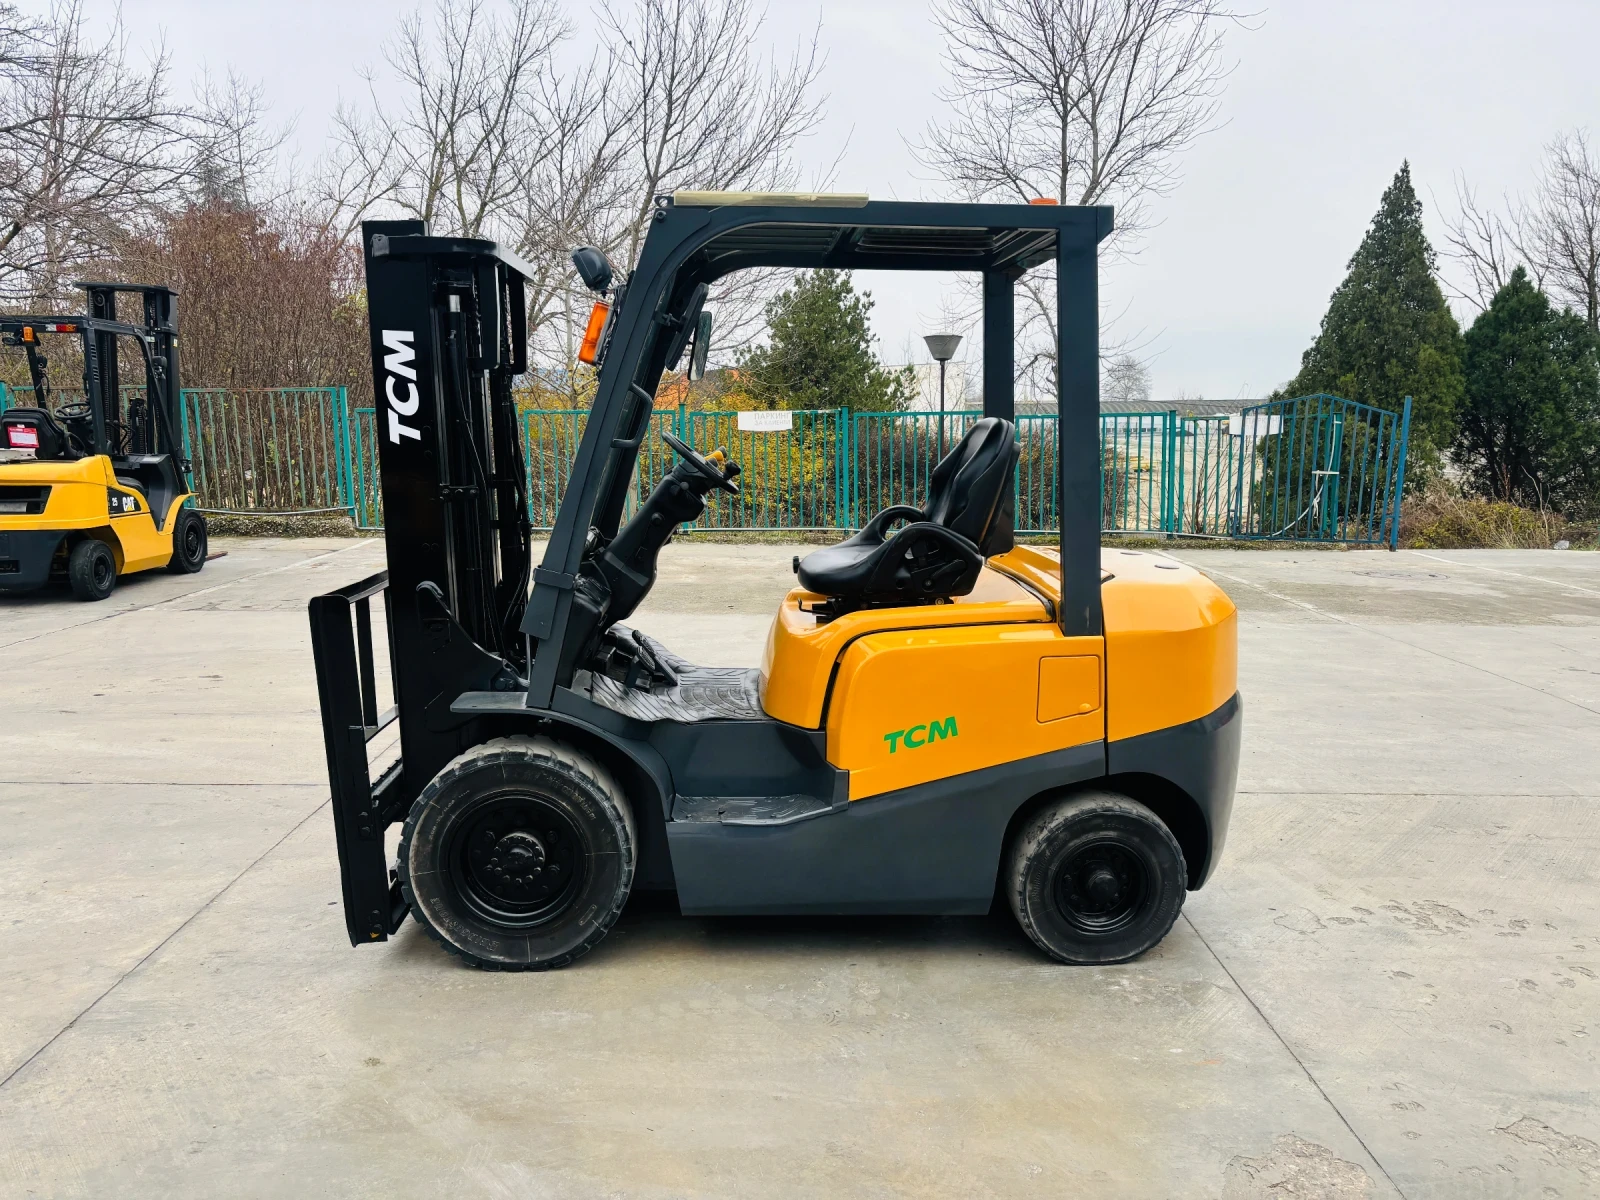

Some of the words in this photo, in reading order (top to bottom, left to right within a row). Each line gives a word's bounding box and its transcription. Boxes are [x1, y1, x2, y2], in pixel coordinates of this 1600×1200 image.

[382, 329, 421, 445] TCM
[754, 412, 790, 420] ПАРКИНГ
[122, 496, 135, 512] CAT
[883, 716, 958, 754] TCM
